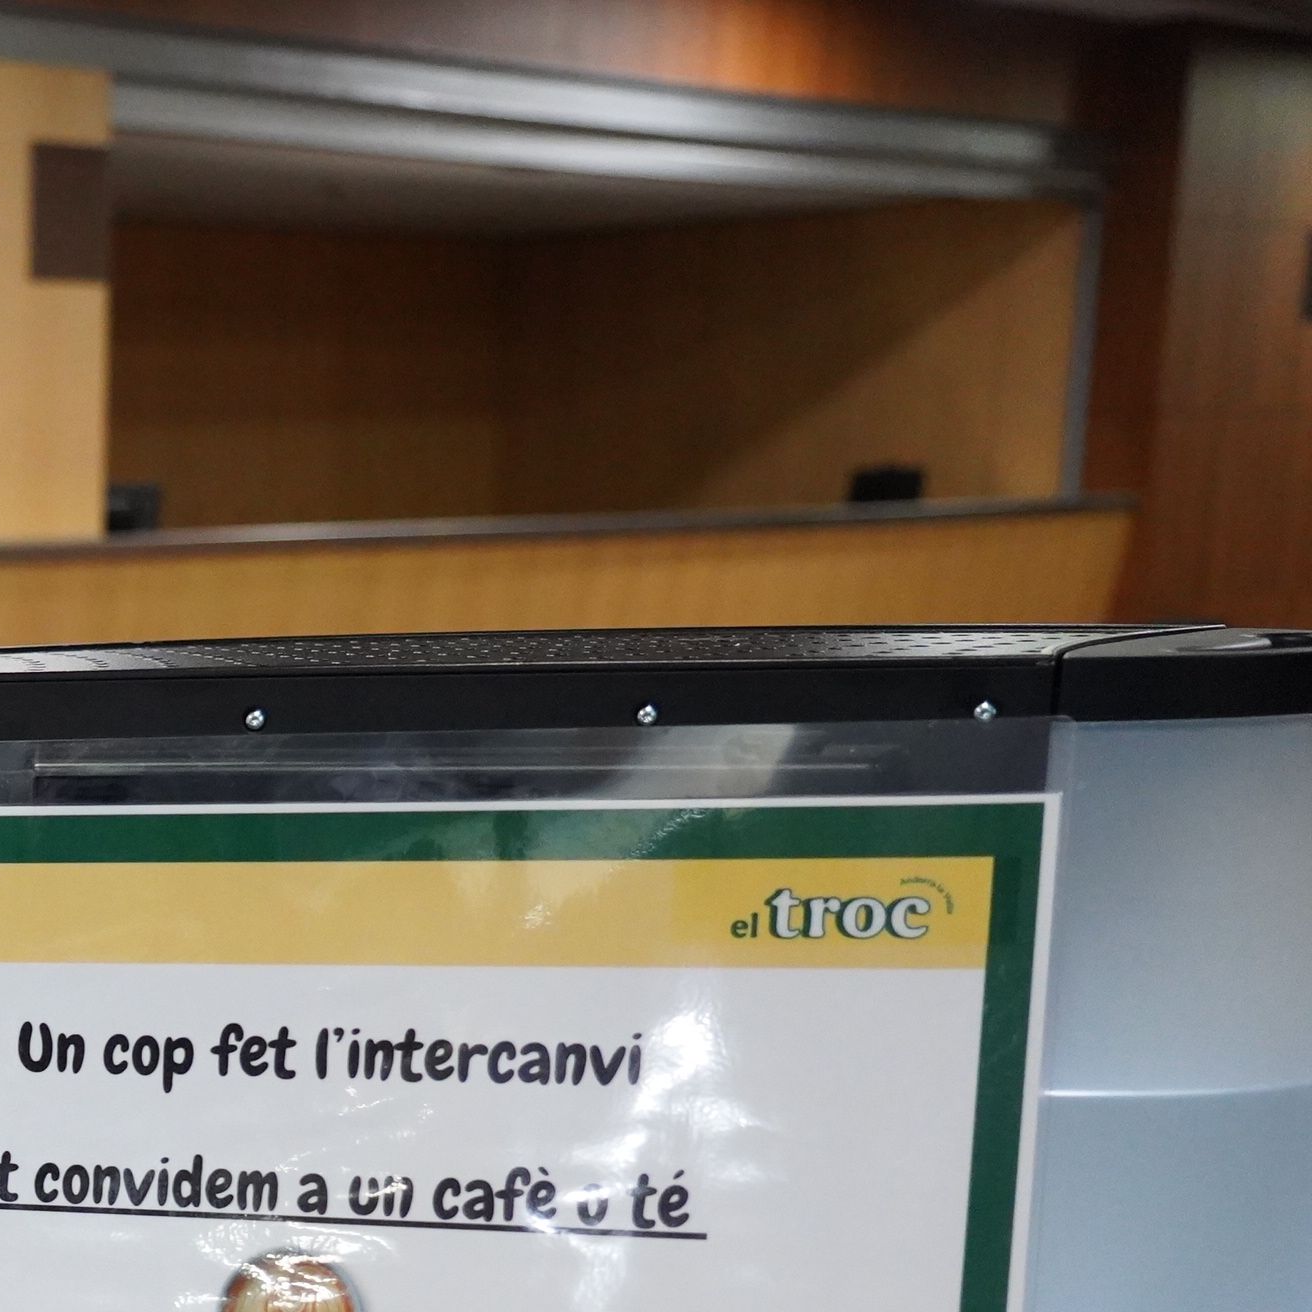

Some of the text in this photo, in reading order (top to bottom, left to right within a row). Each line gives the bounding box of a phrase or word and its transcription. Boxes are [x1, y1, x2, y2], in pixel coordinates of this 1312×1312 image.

[730, 887, 931, 940] el troc
[17, 1021, 86, 1074] Un
[103, 1033, 195, 1094] cop
[210, 1022, 297, 1080] fet
[34, 1154, 279, 1212] convidem
[296, 1173, 329, 1215] a
[348, 1175, 415, 1218] un
[432, 1165, 557, 1222] cafè
[576, 1182, 609, 1227] o
[629, 1168, 690, 1230] té
